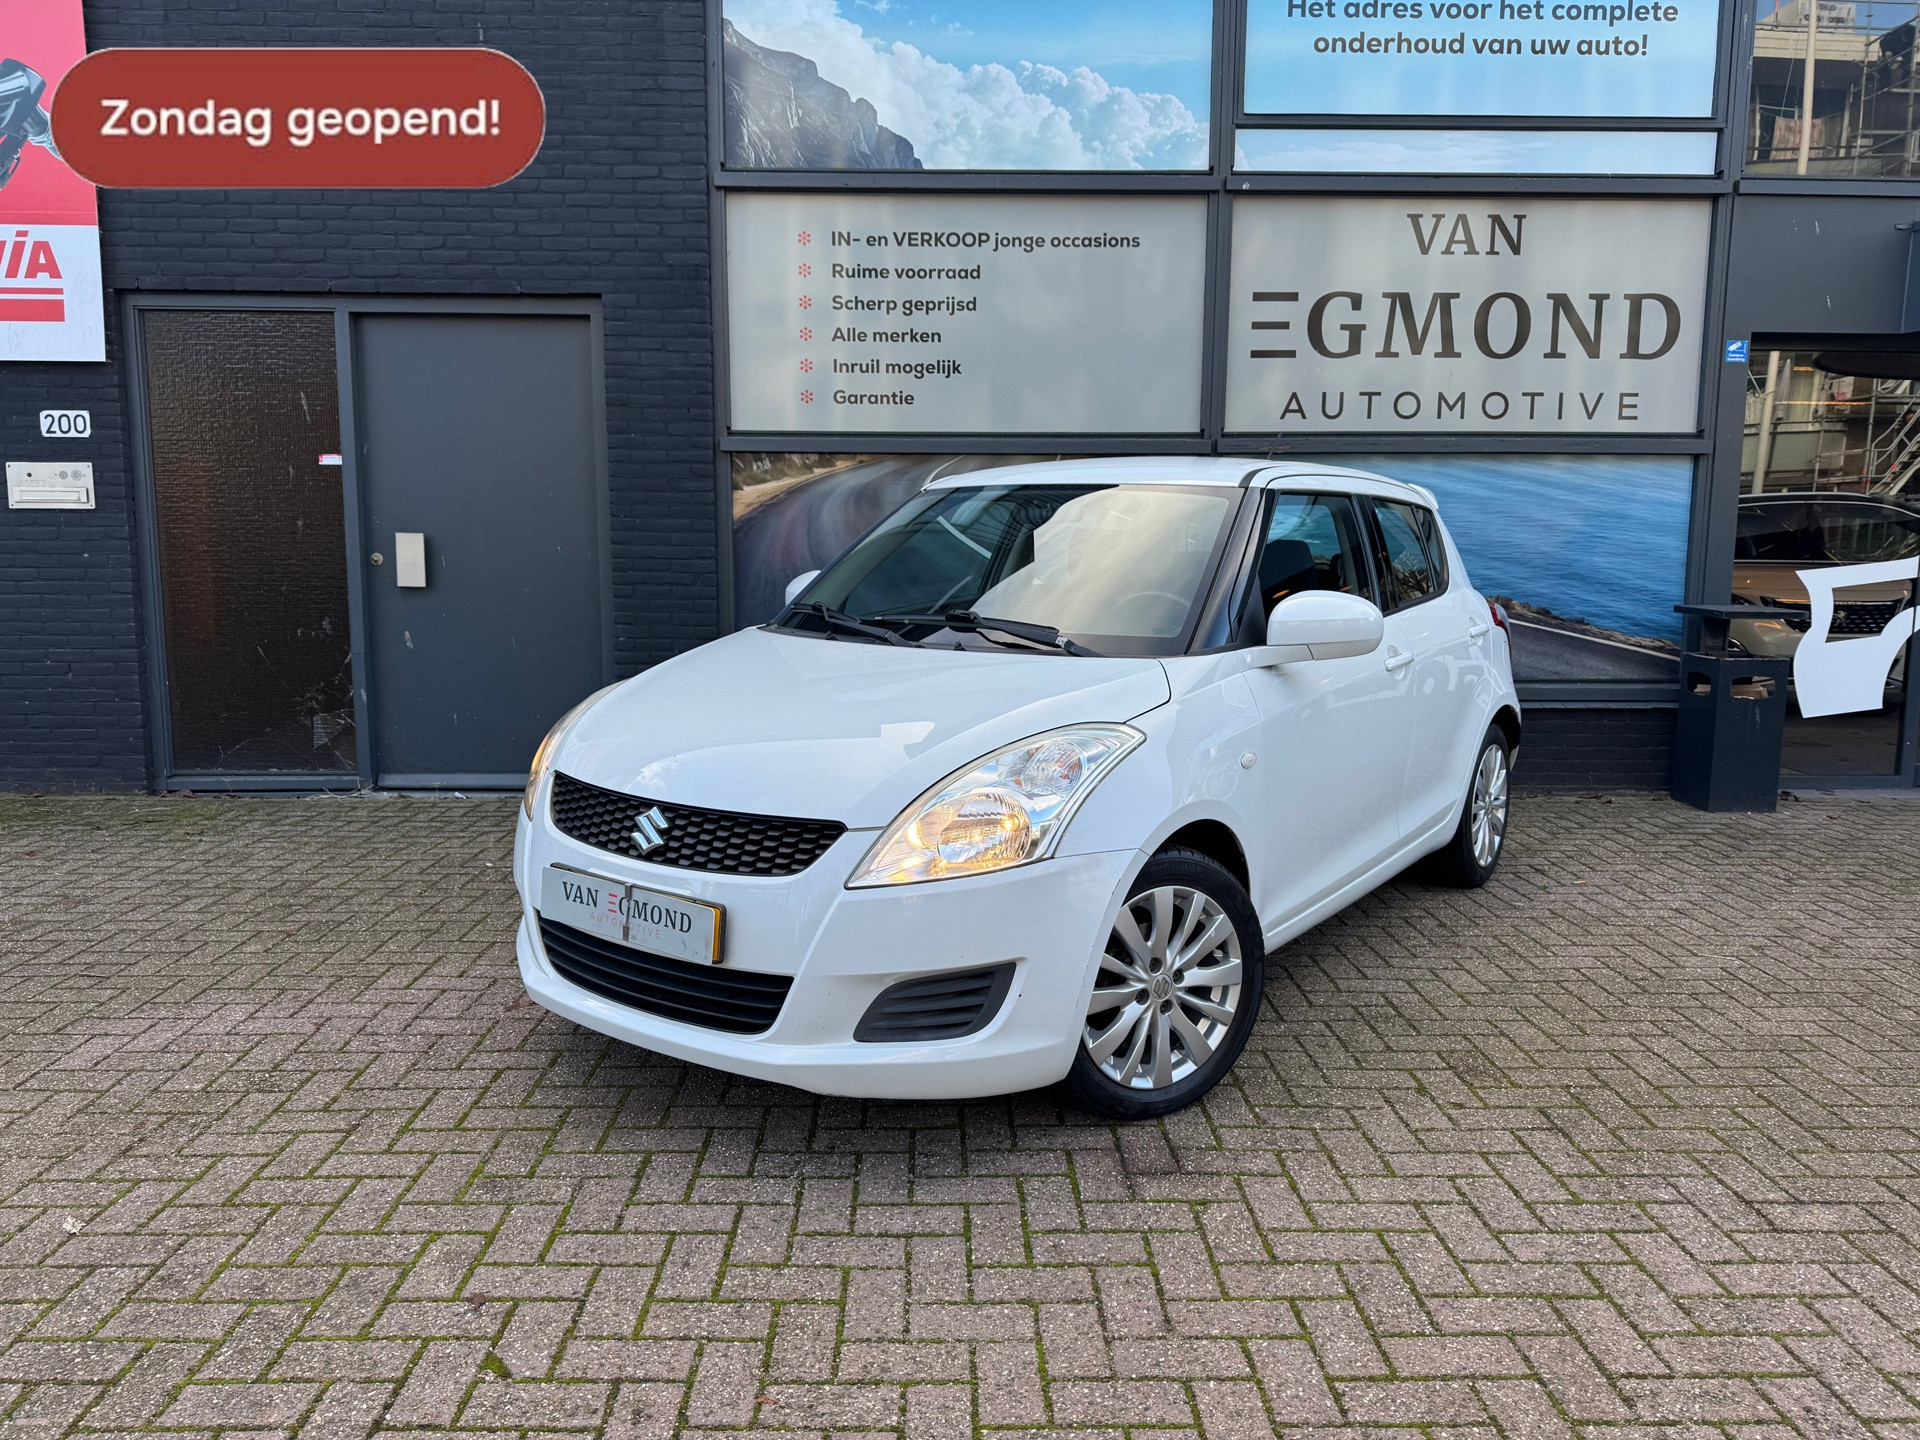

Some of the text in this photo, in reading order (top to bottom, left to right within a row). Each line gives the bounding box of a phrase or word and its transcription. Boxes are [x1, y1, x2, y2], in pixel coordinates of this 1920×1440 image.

[1287, 0, 1679, 27] Het adres voor het complete
[1313, 31, 1648, 56] onderhoud van uw auto!
[831, 231, 1141, 252] IN- en VERKOOP jonge occasions
[1406, 212, 1527, 256] VAN
[832, 263, 981, 280] Ruime voorraad
[832, 295, 977, 316] Scherp geprijsd
[831, 327, 942, 343] Alle merken
[833, 358, 962, 379] Inruil mogelijk
[833, 389, 915, 406] Garantie
[1279, 391, 1640, 421] AUTOMOTIVE
[44, 413, 87, 434] 200
[562, 881, 599, 908] VAN
